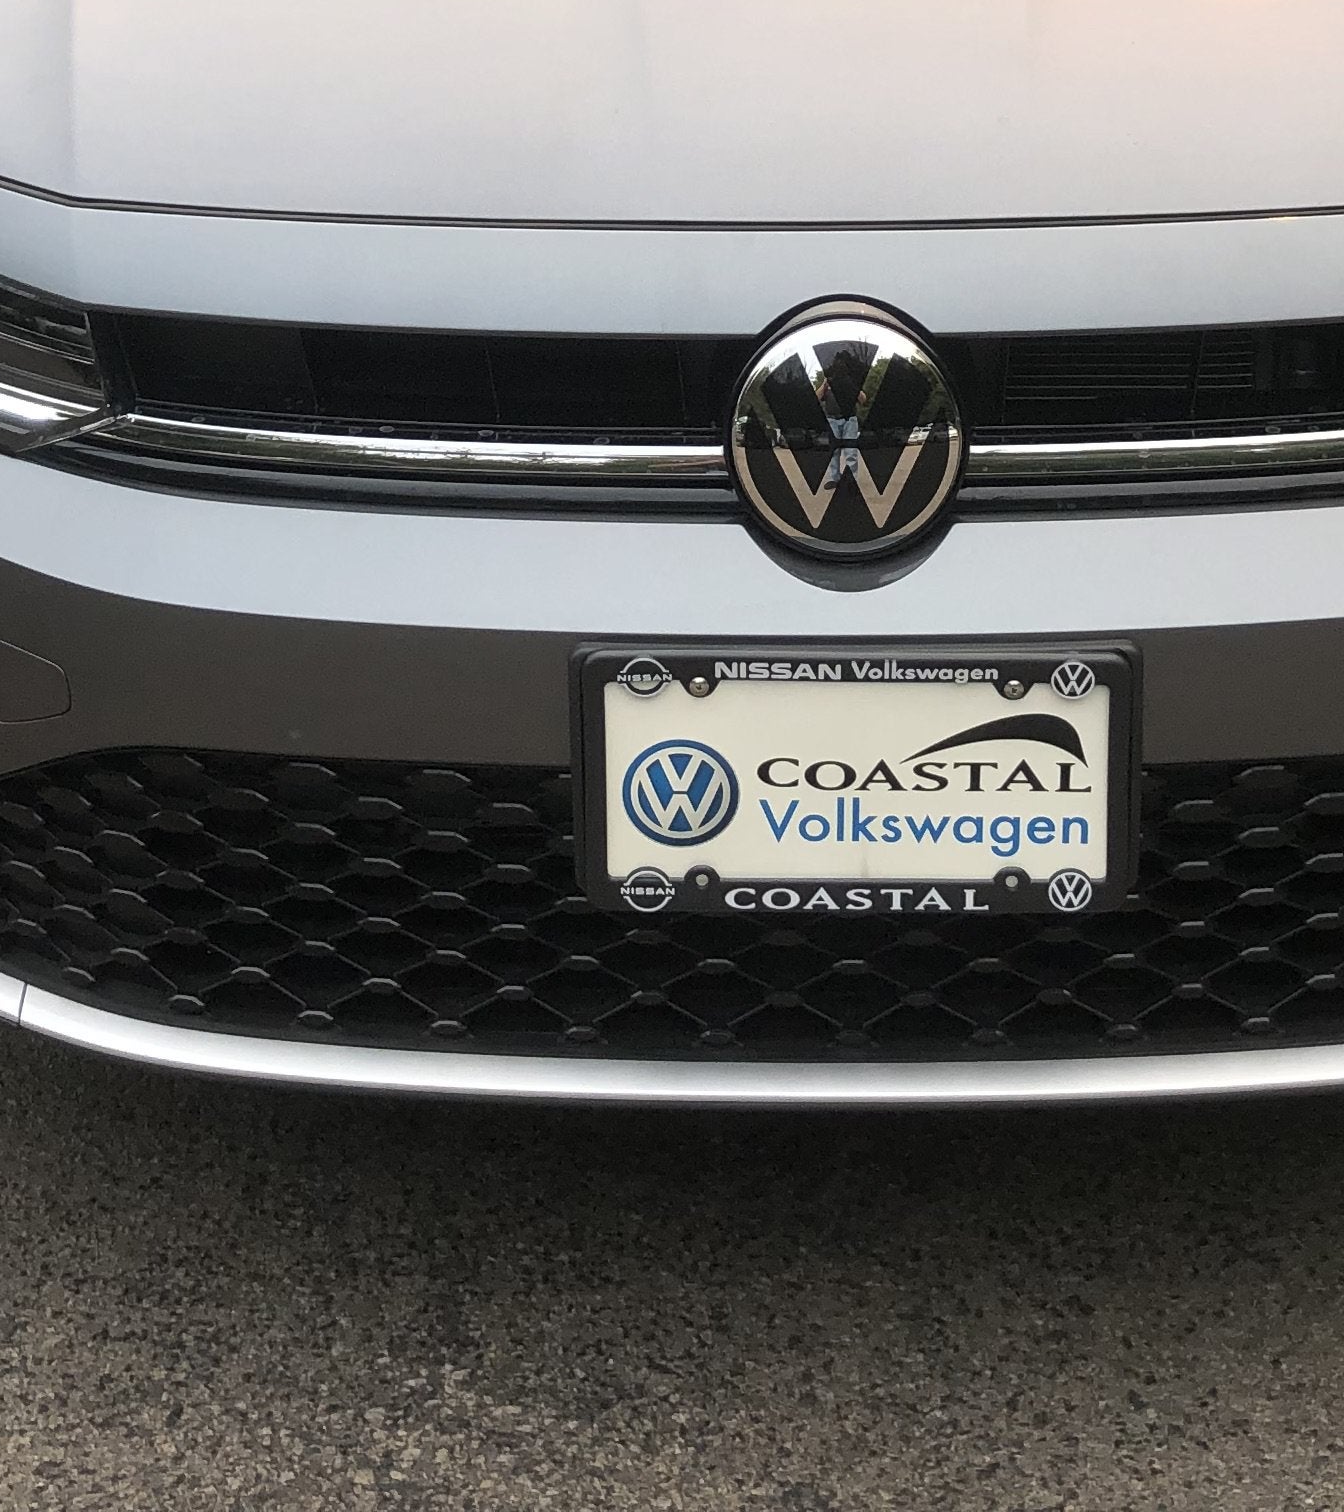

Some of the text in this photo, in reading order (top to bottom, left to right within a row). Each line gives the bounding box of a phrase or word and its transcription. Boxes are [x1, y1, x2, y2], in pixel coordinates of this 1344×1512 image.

[616, 672, 673, 683] NISSAN
[714, 660, 999, 684] NISSAN Volkswagen
[757, 757, 1092, 793] COASTAL
[759, 797, 1089, 857] Volkswagen
[620, 886, 676, 896] NISSAN
[724, 888, 989, 912] COASTAL
